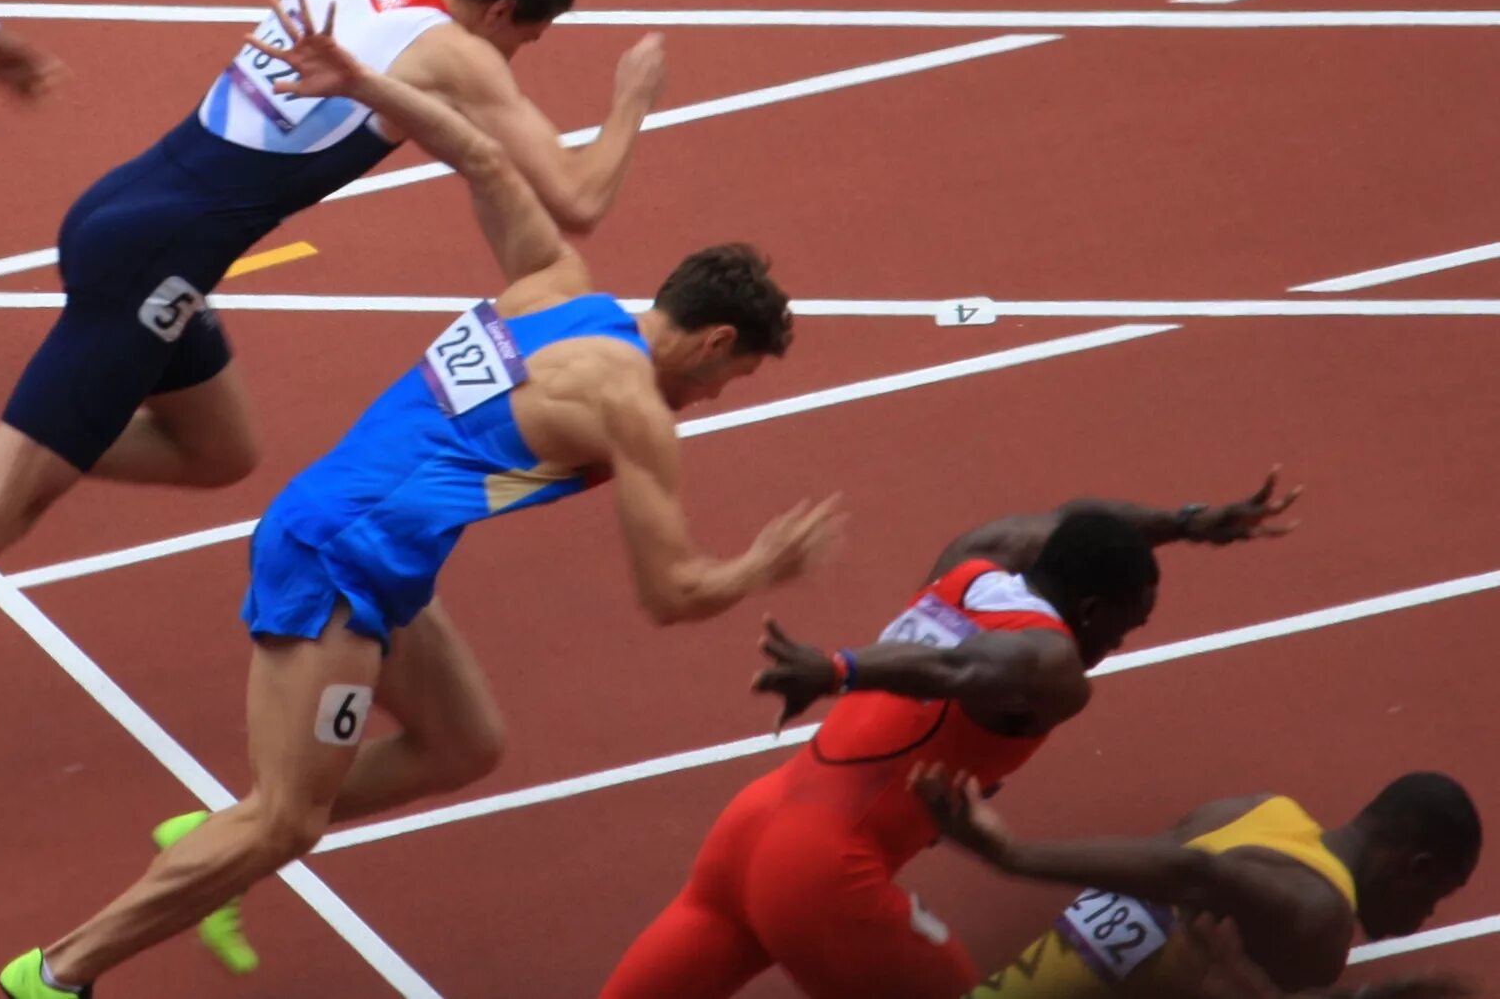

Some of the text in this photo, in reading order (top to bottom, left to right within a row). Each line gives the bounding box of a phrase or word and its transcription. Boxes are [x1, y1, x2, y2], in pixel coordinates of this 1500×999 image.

[153, 292, 195, 330] 5
[954, 304, 980, 323] 4
[333, 692, 357, 741] 6
